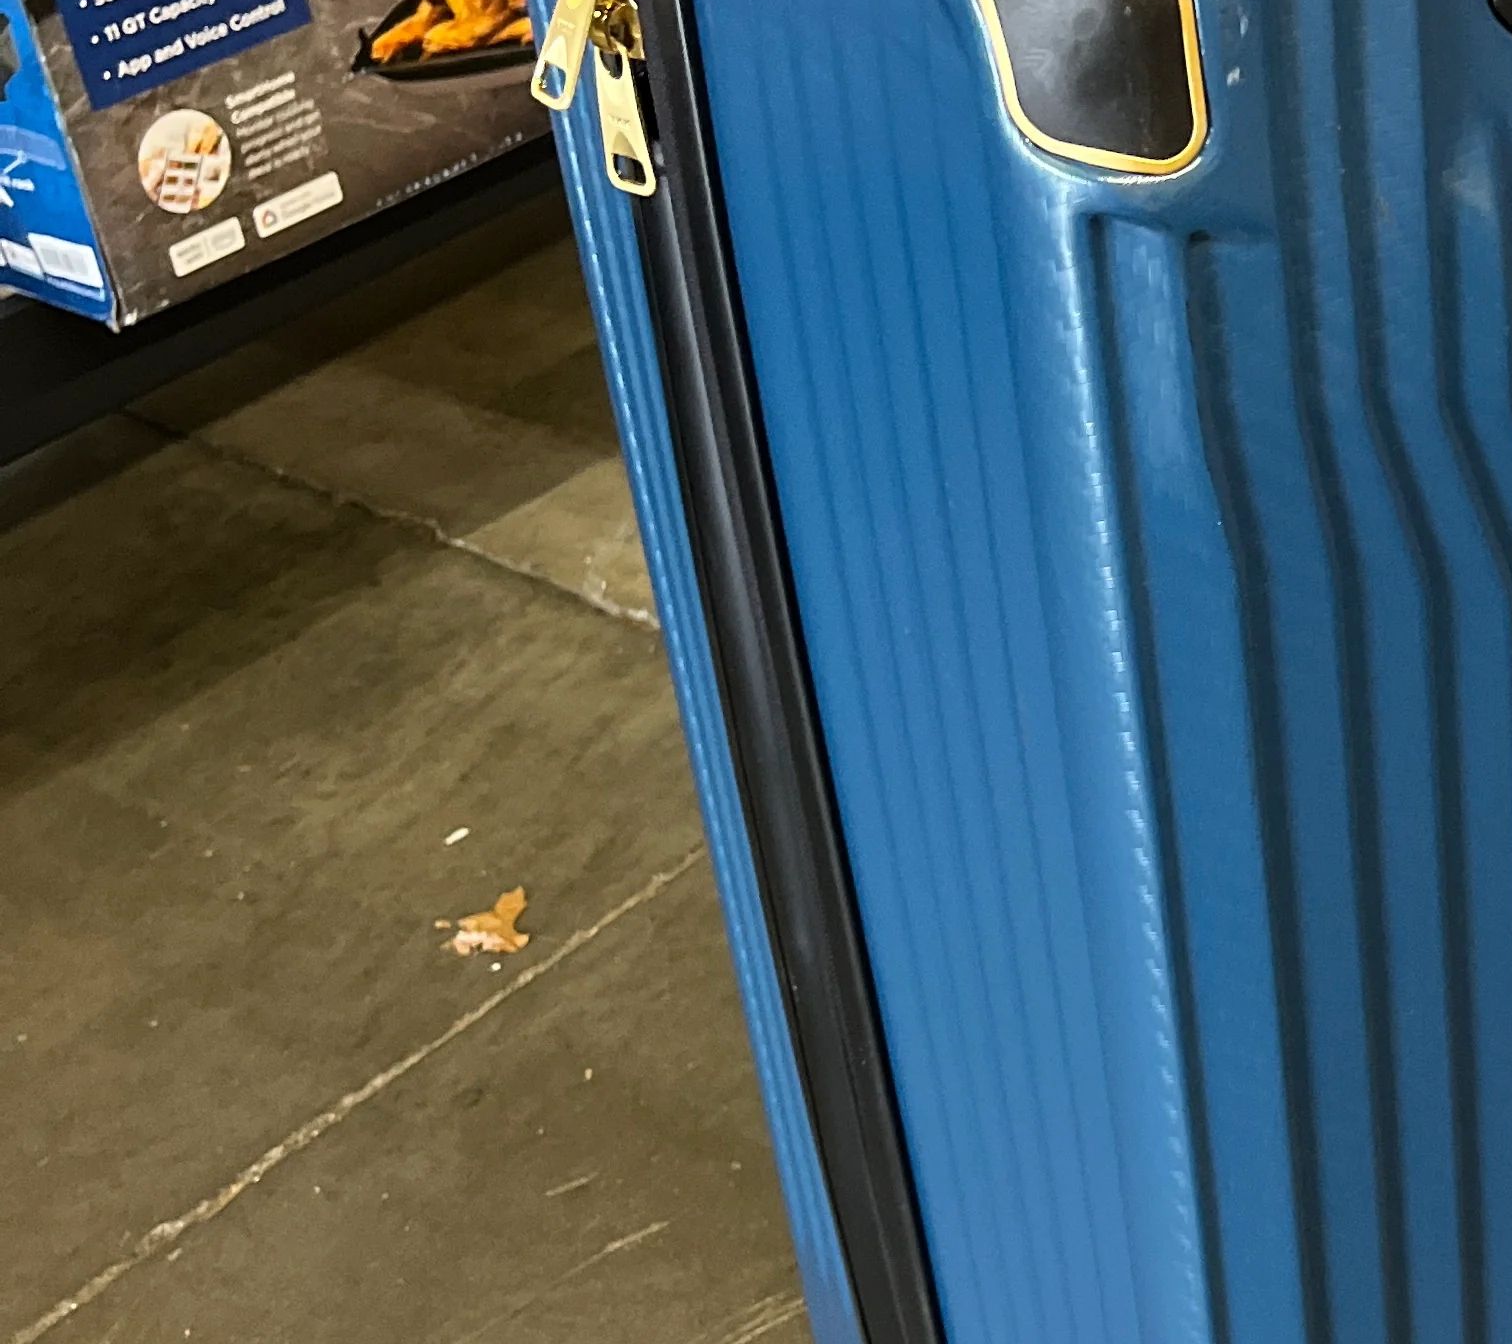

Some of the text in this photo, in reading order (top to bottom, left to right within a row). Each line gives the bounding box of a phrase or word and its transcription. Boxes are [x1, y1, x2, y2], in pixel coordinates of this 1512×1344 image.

[117, 53, 153, 78] App
[153, 37, 184, 64] and
[183, 21, 229, 50] Voice
